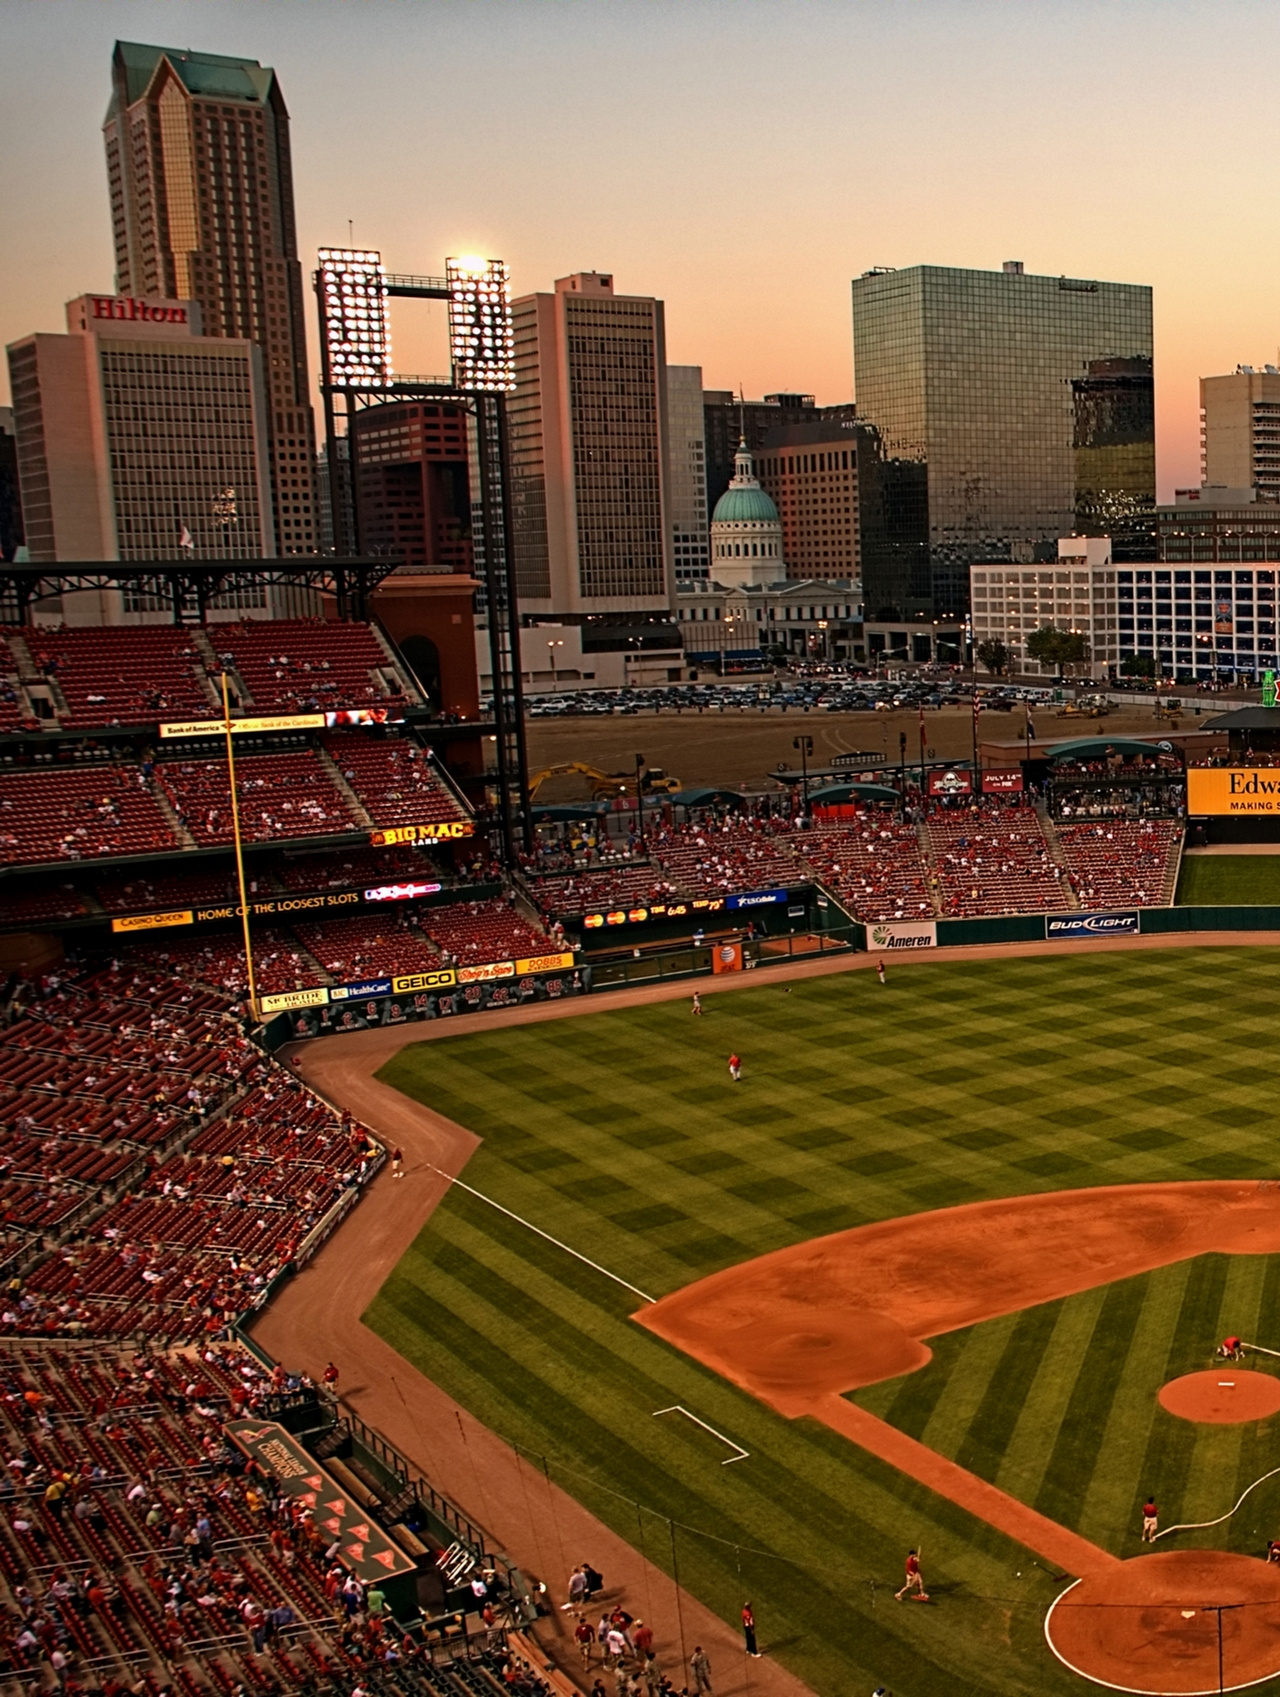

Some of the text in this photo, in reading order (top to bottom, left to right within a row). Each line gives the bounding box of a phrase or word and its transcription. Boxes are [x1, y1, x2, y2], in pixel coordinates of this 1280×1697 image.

[92, 298, 187, 323] Hilton
[193, 725, 219, 733] America
[1231, 801, 1273, 810] MAKING
[383, 823, 464, 845] BIG MAC
[411, 838, 439, 846] LAND
[198, 907, 234, 921] HOME
[253, 902, 275, 914] THE
[277, 897, 325, 911] LOOSEST
[327, 893, 359, 905] SLOTS
[121, 917, 151, 927] CASINO
[154, 913, 184, 923] QUEEN
[1049, 917, 1135, 930] BUD LIGHT
[887, 934, 931, 948] Ameren
[529, 956, 562, 968] DOBBS
[397, 973, 452, 990] GEICO
[350, 983, 389, 995] HealthCare
